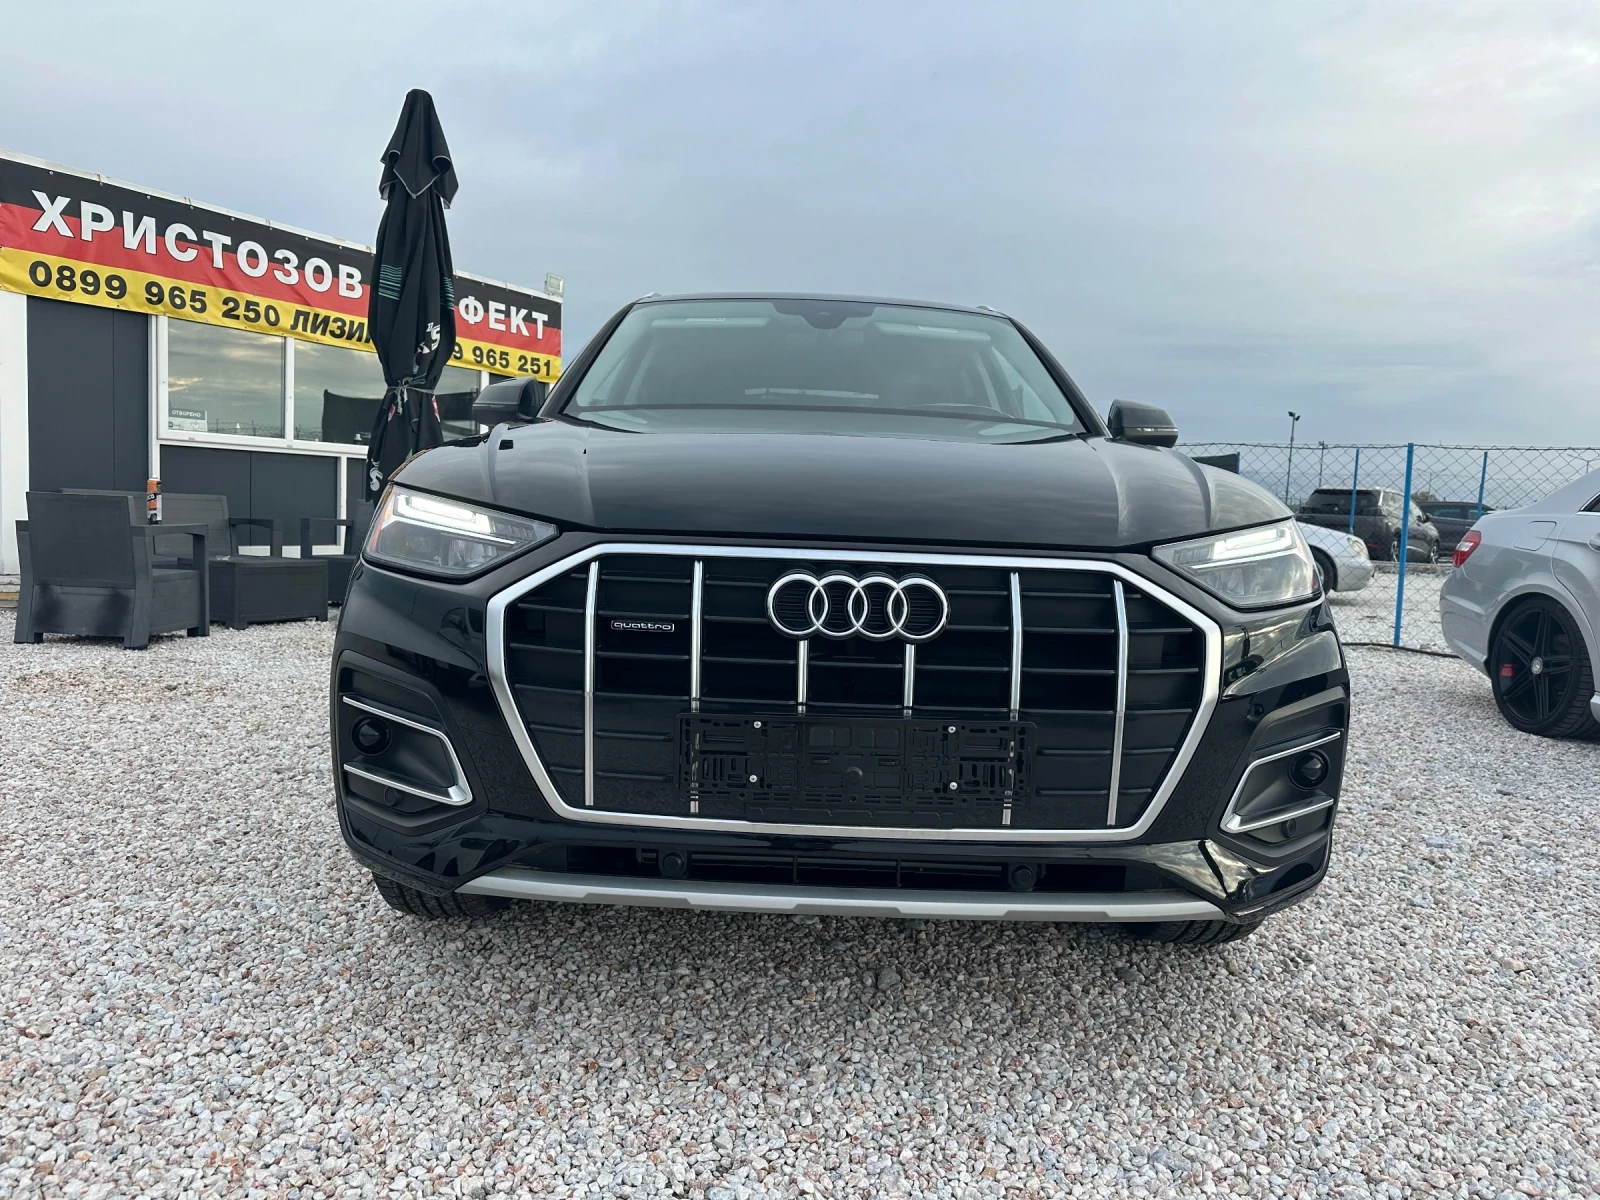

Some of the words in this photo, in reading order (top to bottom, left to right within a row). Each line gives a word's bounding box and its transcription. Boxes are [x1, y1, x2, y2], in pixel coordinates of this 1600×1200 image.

[31, 189, 363, 299] ХРИСТОЗОВ
[458, 295, 549, 340] ФЕКТ
[28, 260, 128, 299] 0899
[144, 281, 208, 314] 965
[221, 296, 280, 327] 250
[473, 345, 510, 369] 965
[517, 354, 551, 377] 251
[171, 409, 202, 418] ОТВОРЕНО
[613, 622, 672, 630] quattro
